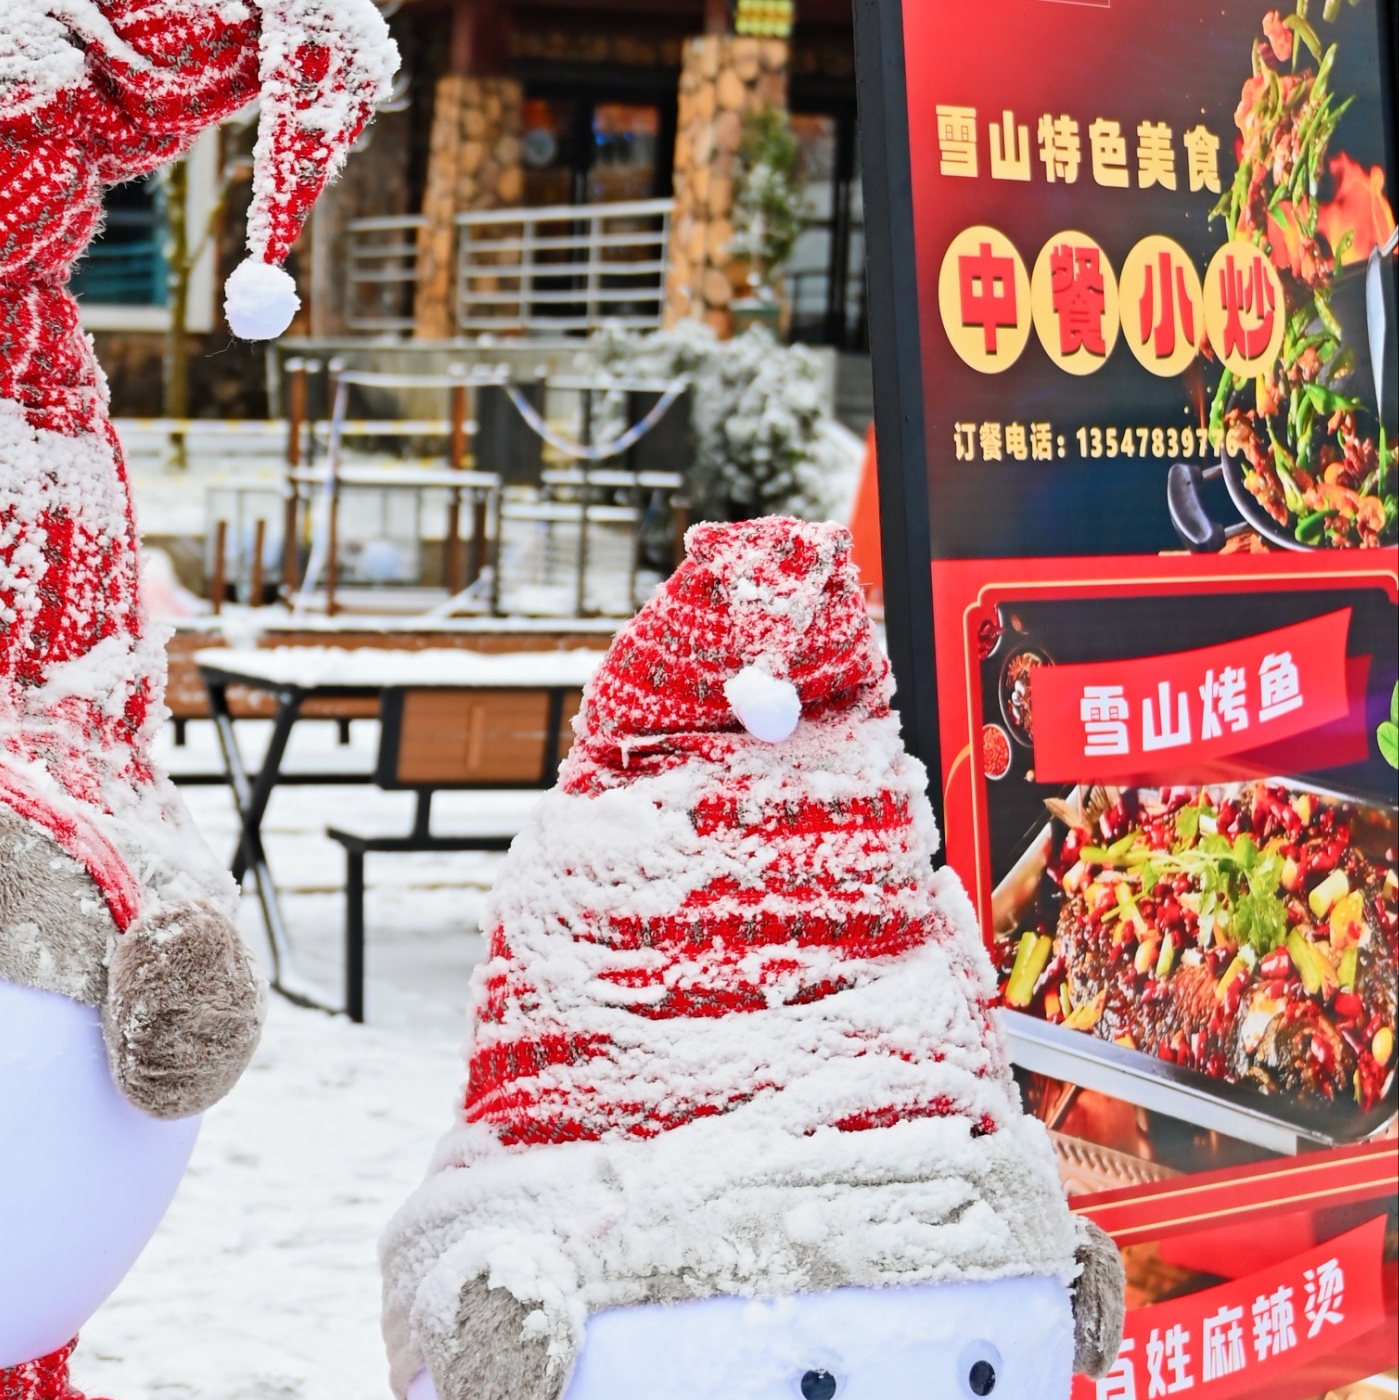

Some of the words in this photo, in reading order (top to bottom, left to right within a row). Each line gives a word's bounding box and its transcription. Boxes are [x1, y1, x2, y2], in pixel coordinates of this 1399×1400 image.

[936, 104, 1221, 193] 雪山特色美食
[957, 242, 1276, 361] 中餐小炒
[1079, 650, 1304, 757] 雪山烤鱼
